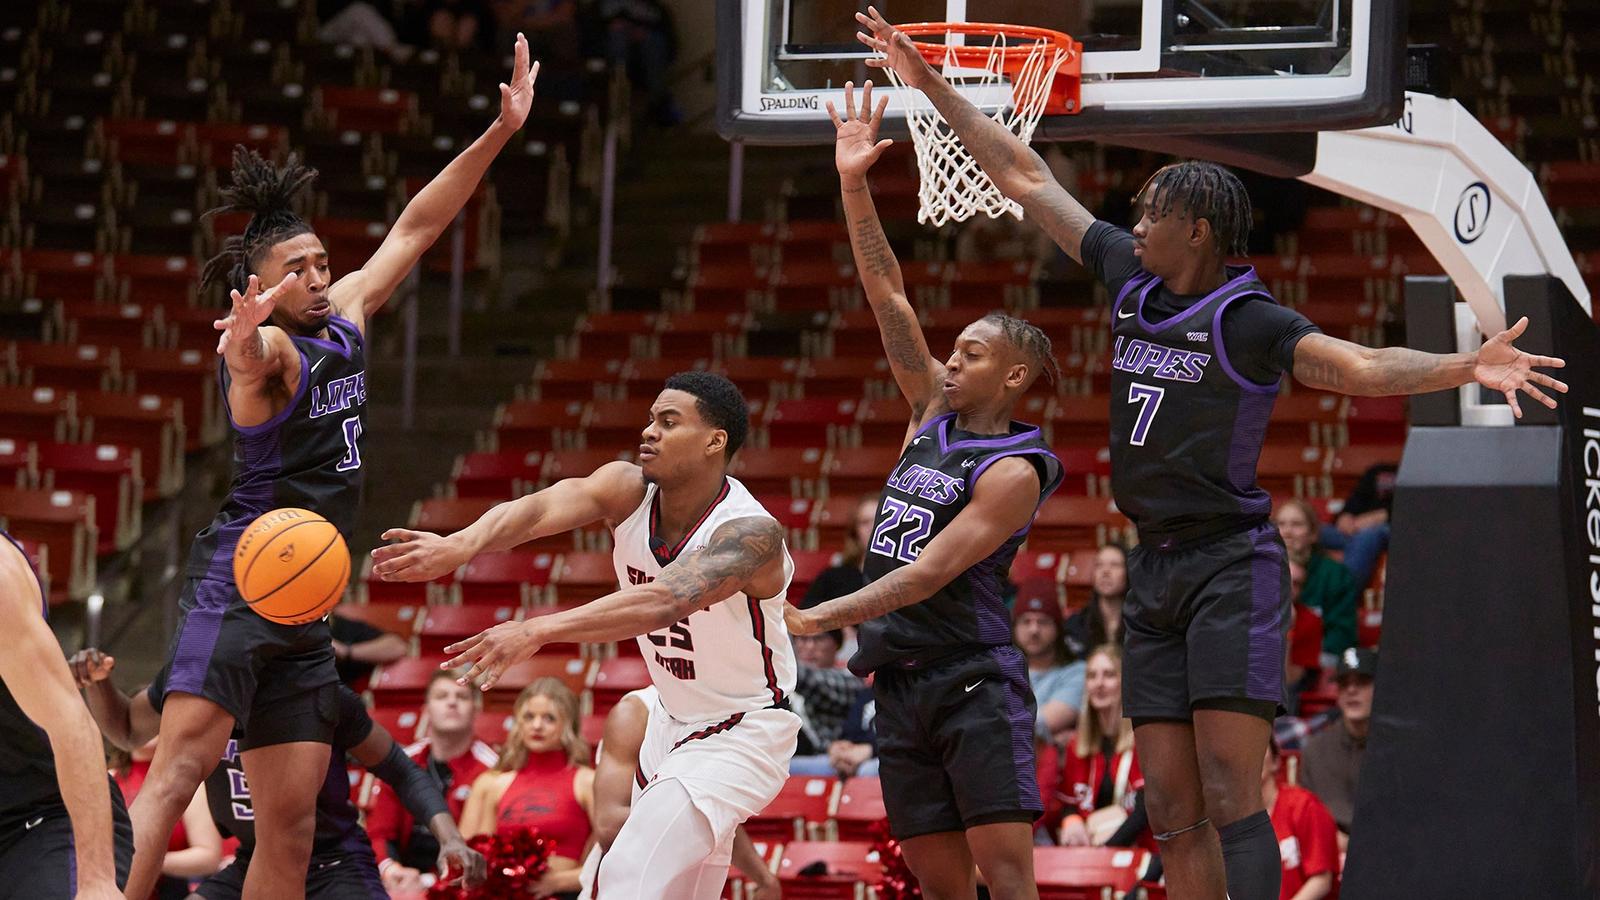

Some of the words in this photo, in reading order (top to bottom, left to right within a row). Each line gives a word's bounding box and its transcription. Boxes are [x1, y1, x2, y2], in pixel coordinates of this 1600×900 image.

[760, 95, 818, 112] SPALDING
[1112, 335, 1212, 383] LOPES
[1186, 331, 1209, 342] WAC
[1127, 382, 1165, 447] 7
[887, 457, 965, 506] LOPES
[870, 495, 935, 564] 22
